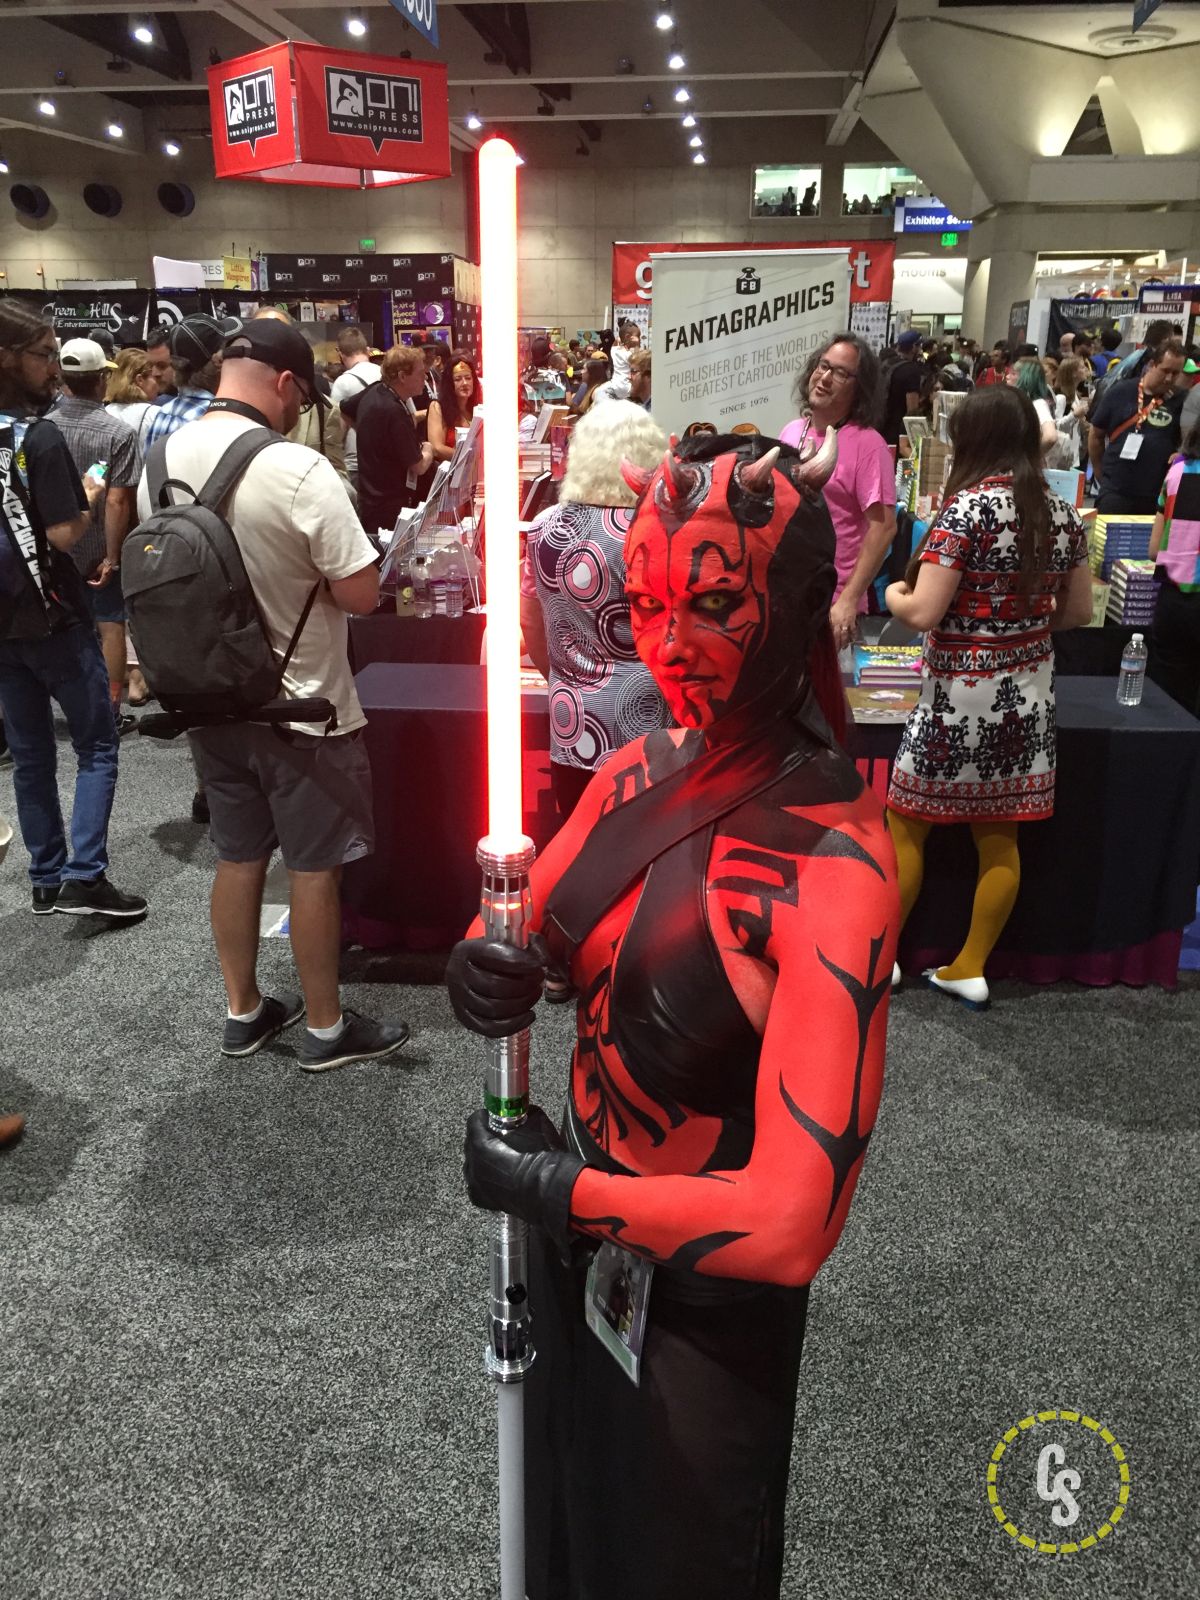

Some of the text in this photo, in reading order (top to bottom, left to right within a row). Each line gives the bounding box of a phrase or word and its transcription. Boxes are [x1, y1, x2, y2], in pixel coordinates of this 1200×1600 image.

[245, 106, 275, 121] PRESS
[368, 110, 418, 123] PRESS
[229, 121, 275, 137] www.onipress.com
[332, 120, 419, 135] www.onipress.com
[905, 215, 945, 225] Exhibitor
[201, 265, 225, 275] RES
[665, 280, 835, 353] FANTAGRAPHICS
[57, 320, 107, 329] Entertainment
[669, 330, 830, 389] PUBLISHER OF THE WORLD'S
[680, 354, 808, 403] GREATEST CARTOONIST
[719, 396, 769, 416] SINCE 1976
